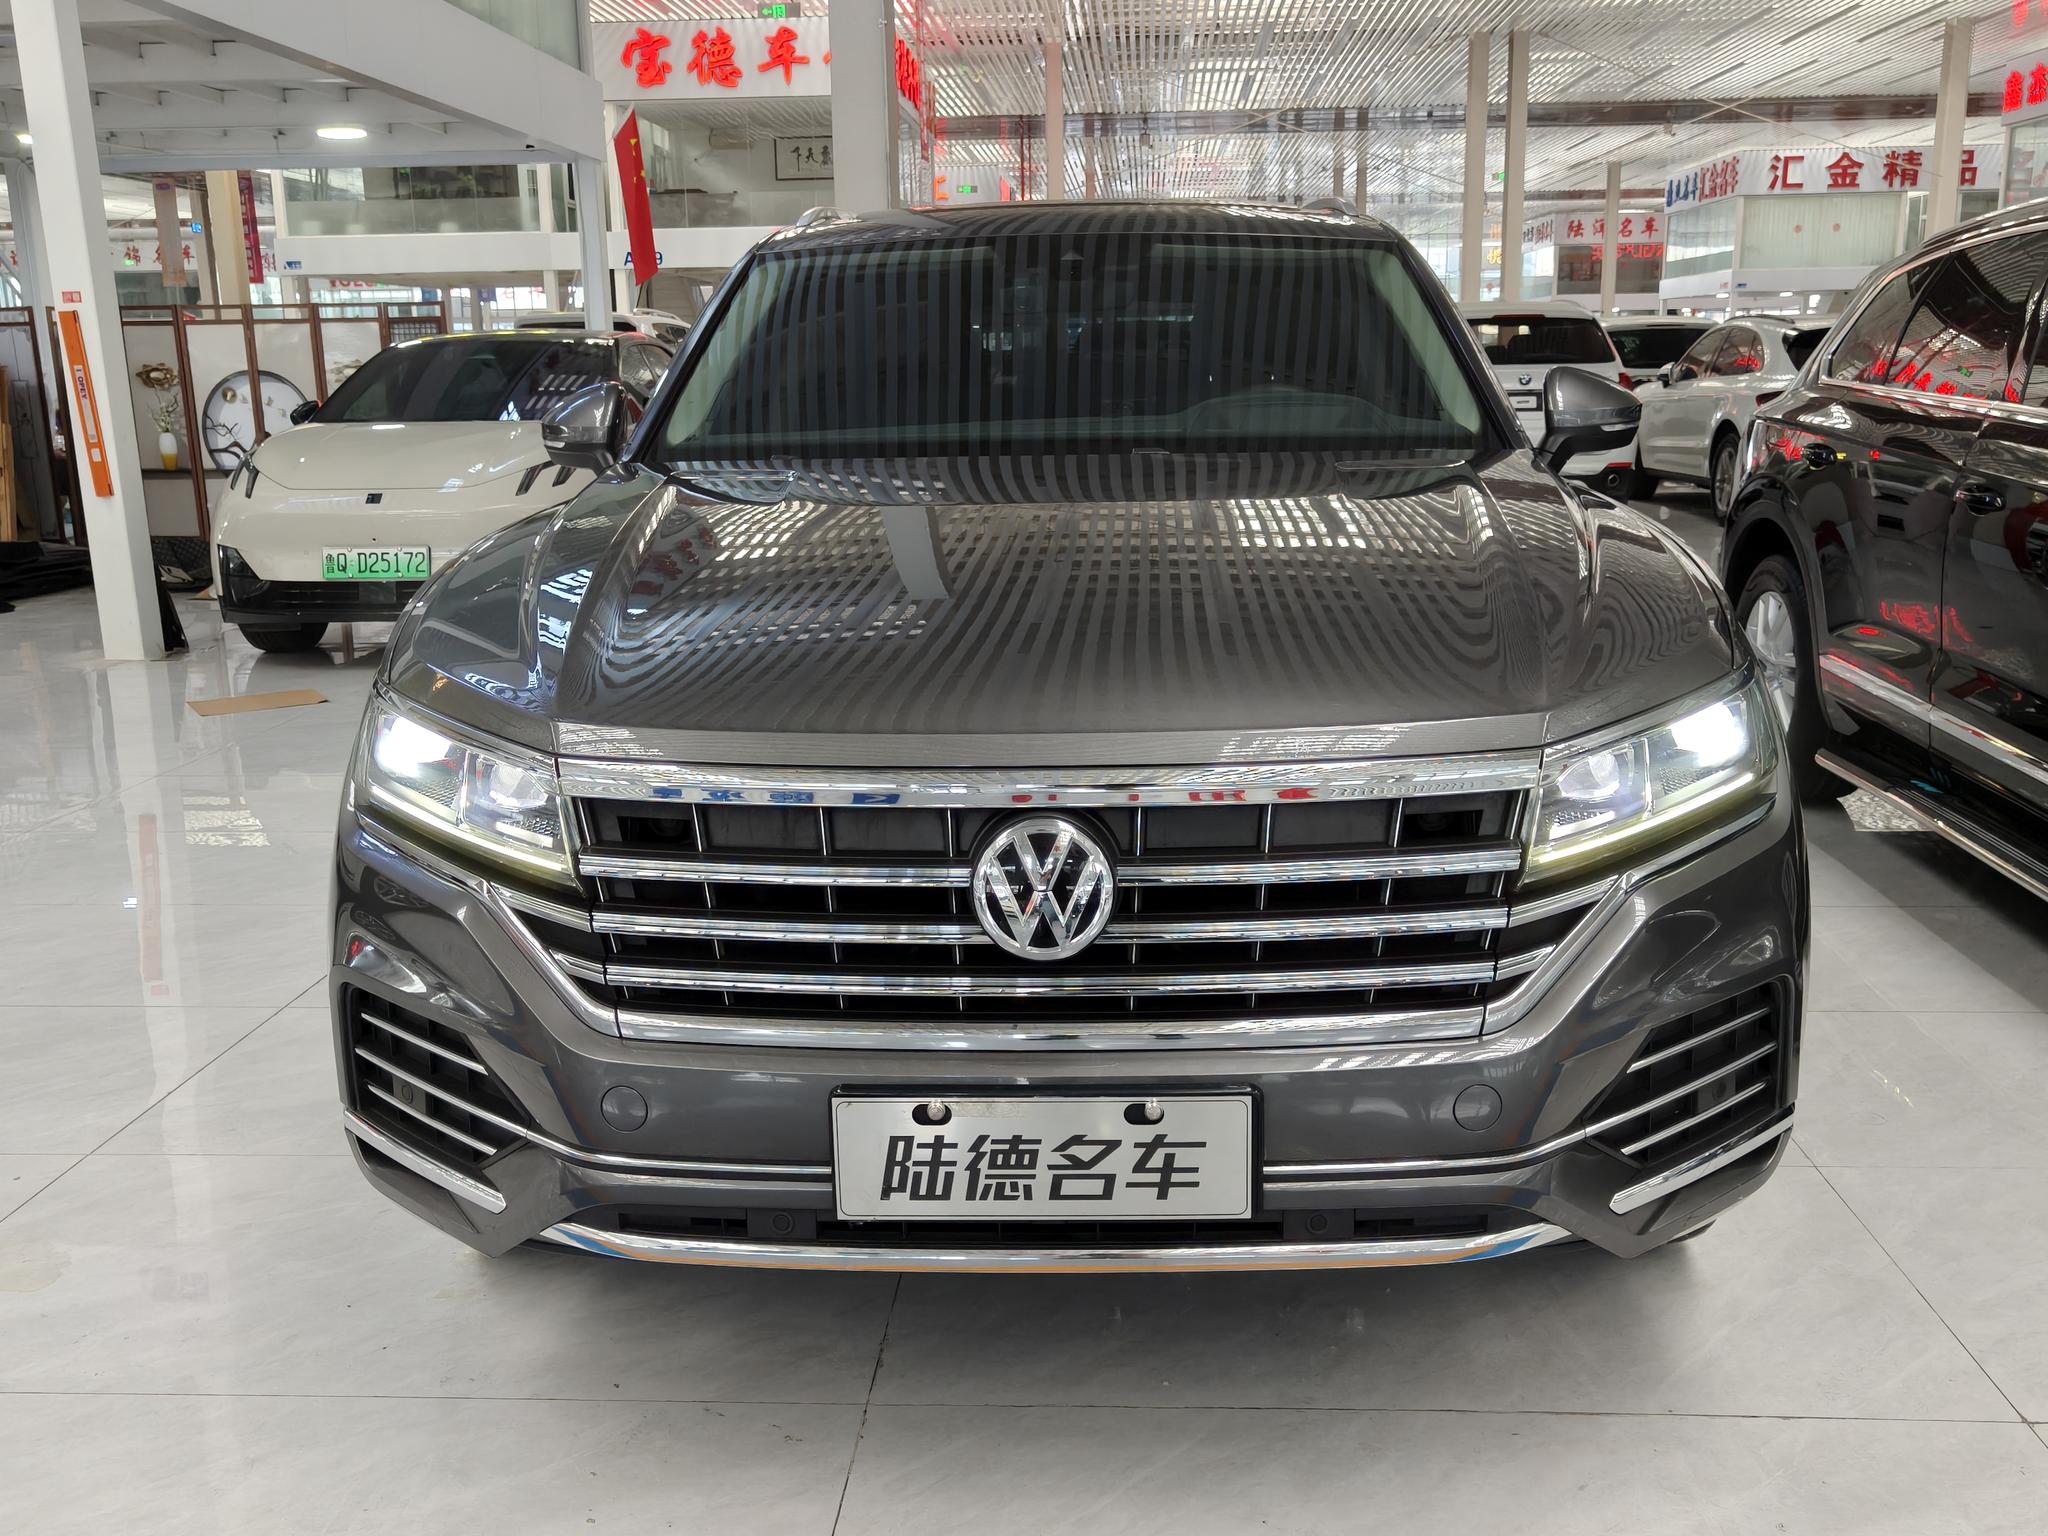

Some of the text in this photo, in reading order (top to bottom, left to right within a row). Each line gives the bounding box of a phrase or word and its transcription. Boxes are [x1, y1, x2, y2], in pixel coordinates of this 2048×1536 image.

[620, 26, 831, 88] 宝德车
[880, 1133, 1206, 1201] 陆德名车
